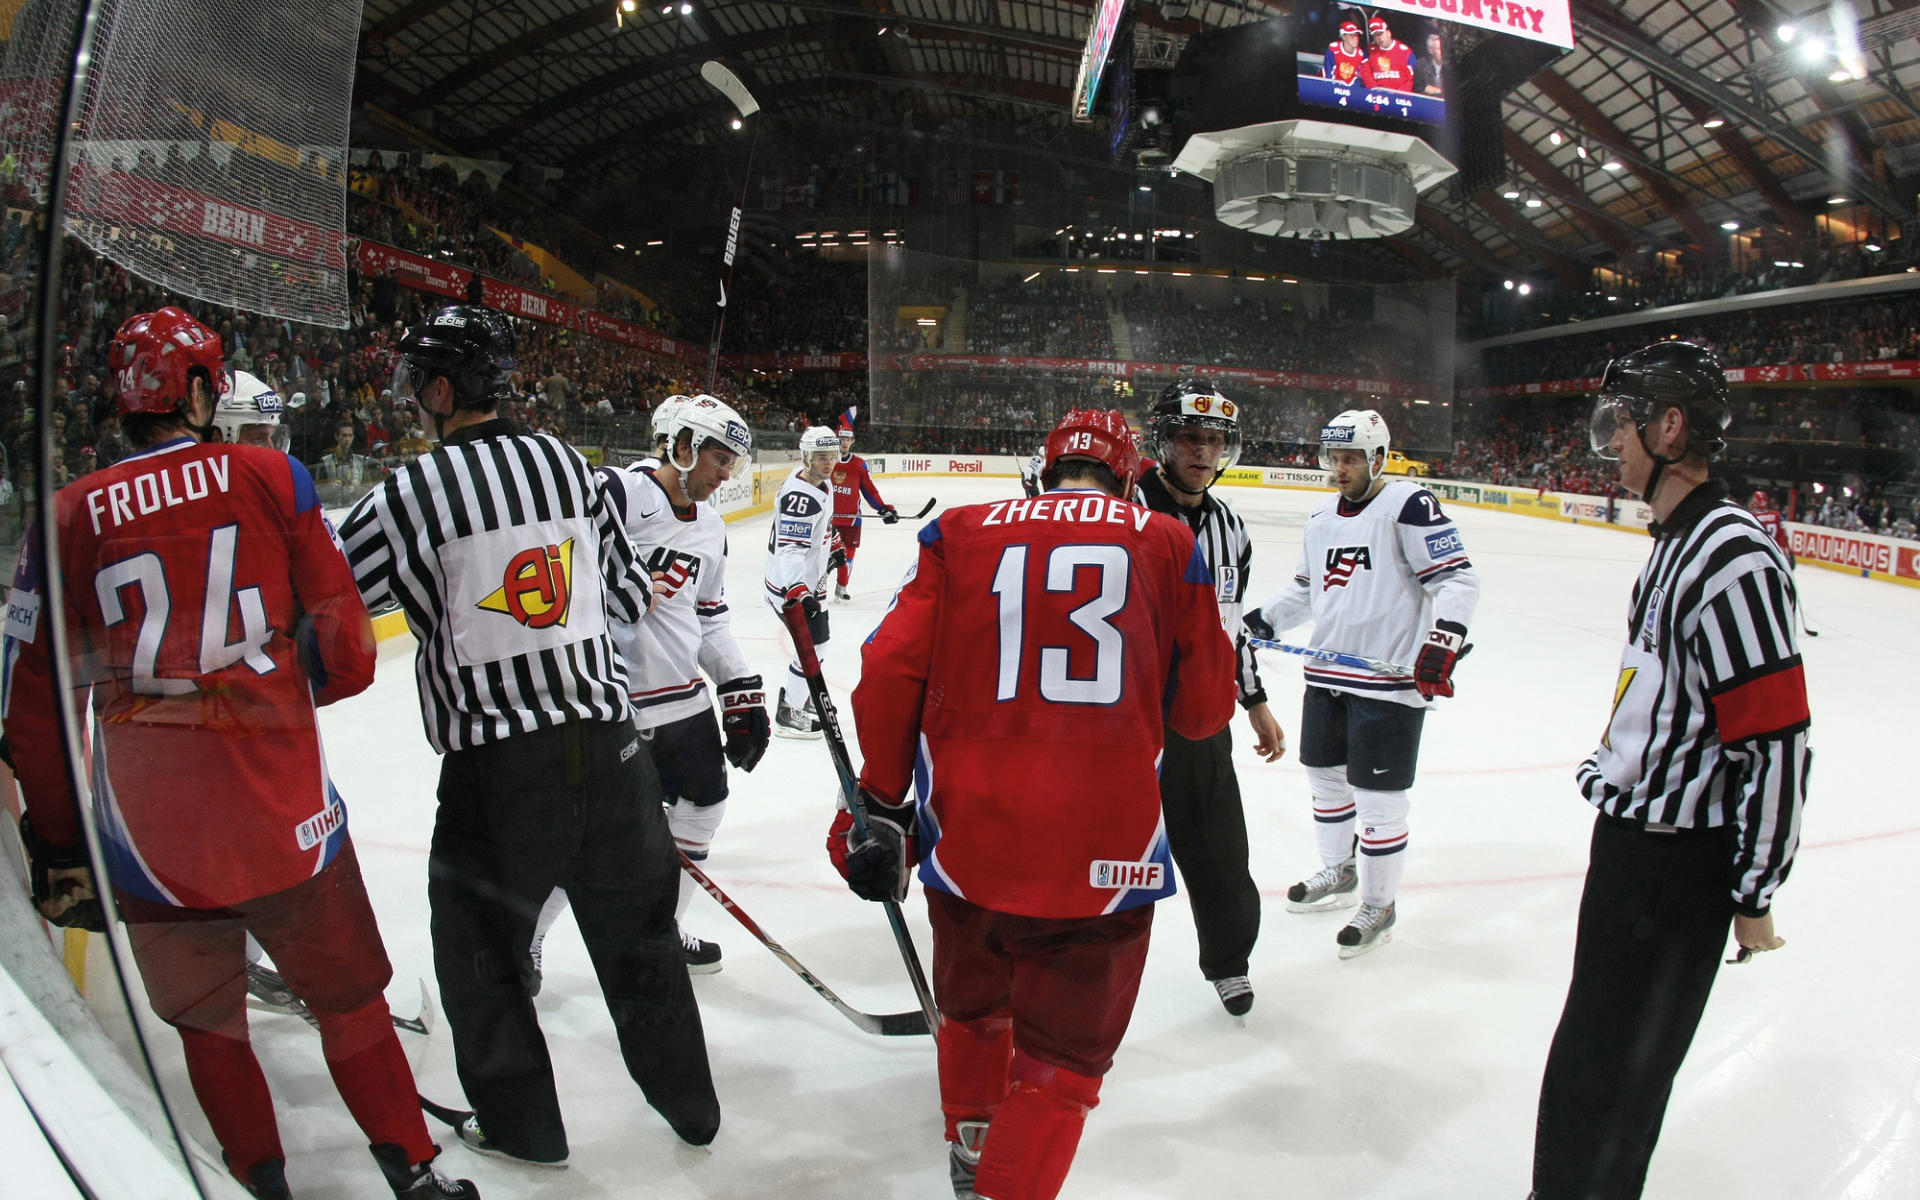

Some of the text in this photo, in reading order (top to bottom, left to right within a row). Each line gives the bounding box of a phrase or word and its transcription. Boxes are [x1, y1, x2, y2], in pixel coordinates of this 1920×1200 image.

[1334, 87, 1351, 96] RUS
[1338, 97, 1347, 107] 4
[1365, 94, 1389, 106] 4:54
[1395, 98, 1412, 107] USA
[1401, 107, 1408, 117] 1
[202, 201, 266, 245] BERN
[723, 206, 742, 267] BAUER
[520, 292, 547, 318] BERN
[437, 317, 466, 327] CCM
[803, 355, 842, 368] BERN
[1088, 361, 1127, 375] BERN
[118, 366, 135, 393] 24
[1356, 379, 1390, 394] BERN
[1072, 431, 1092, 451] 13
[907, 459, 931, 472] IIHF
[949, 460, 983, 473] Persil
[1238, 472, 1260, 480] БАНК
[1285, 472, 1325, 483] TISSOT
[86, 454, 229, 536] FROLOV
[786, 494, 809, 515] 26
[981, 497, 1152, 532] ZHERDEV
[1419, 495, 1446, 522] 2
[1793, 533, 1890, 570] BAUHAUS
[647, 546, 702, 599] USA
[1323, 546, 1372, 592] USA
[94, 521, 279, 696] 24
[990, 542, 1132, 708] 13
[823, 695, 842, 739] CCM
[311, 803, 340, 840] IIHF
[1112, 864, 1159, 887] IIHF
